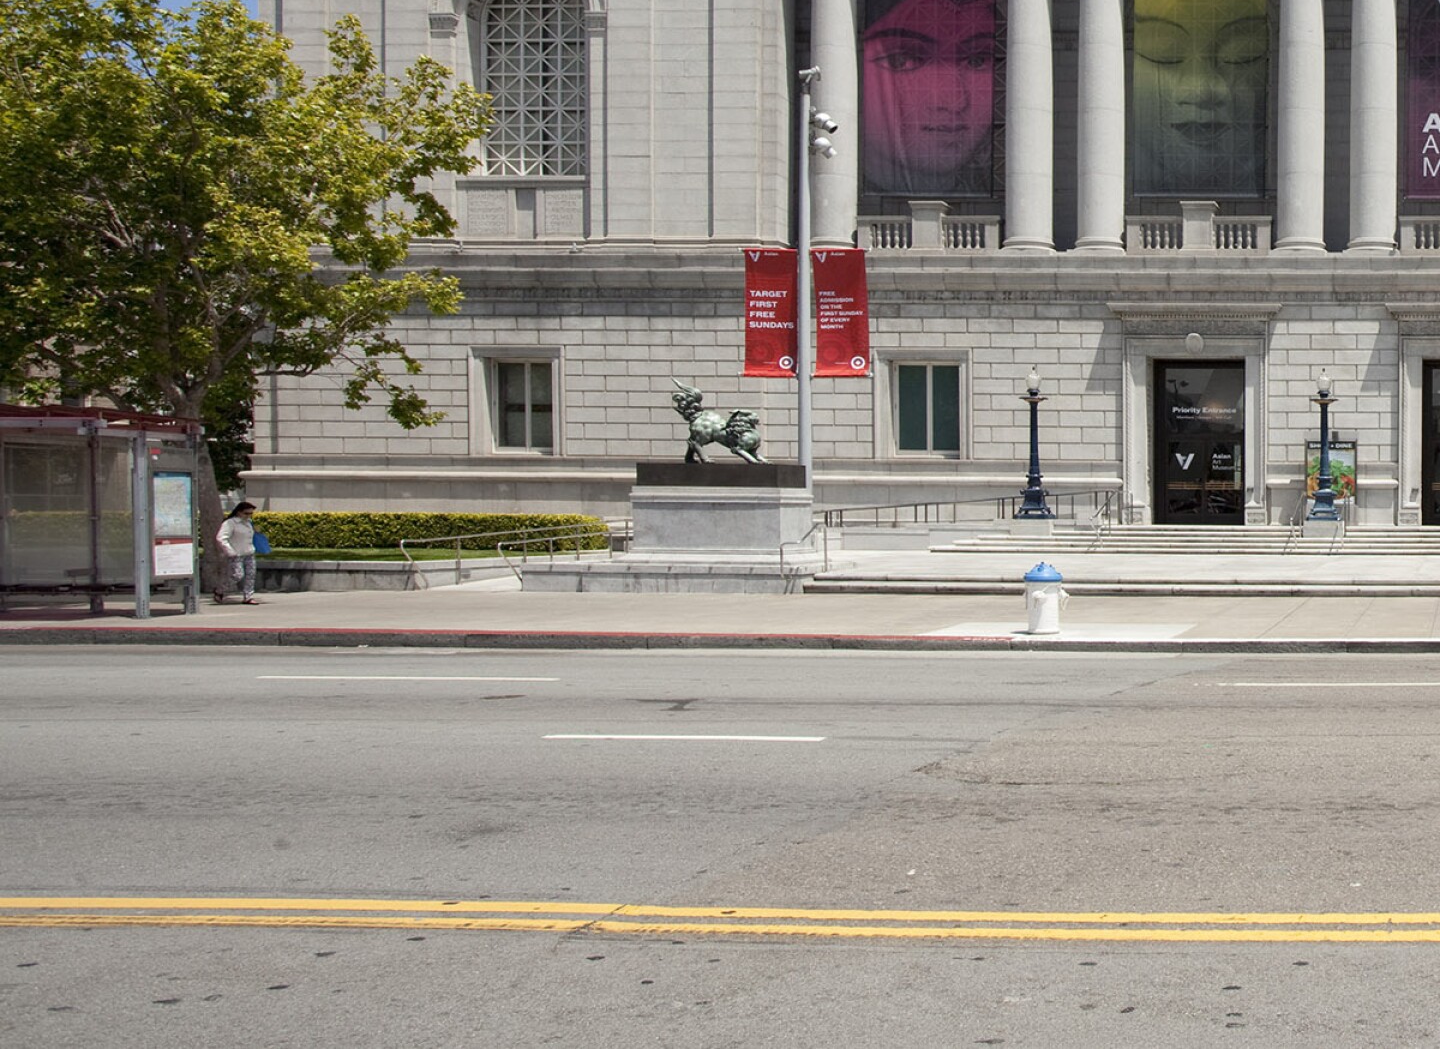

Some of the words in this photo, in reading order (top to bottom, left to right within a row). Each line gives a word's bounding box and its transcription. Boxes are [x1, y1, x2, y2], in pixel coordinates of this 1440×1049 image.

[749, 290, 788, 298] TARGET
[749, 300, 778, 308] FIRST
[749, 321, 794, 329] SUNDAYS
[1172, 406, 1200, 415] Priority
[1201, 406, 1237, 414] Entrance
